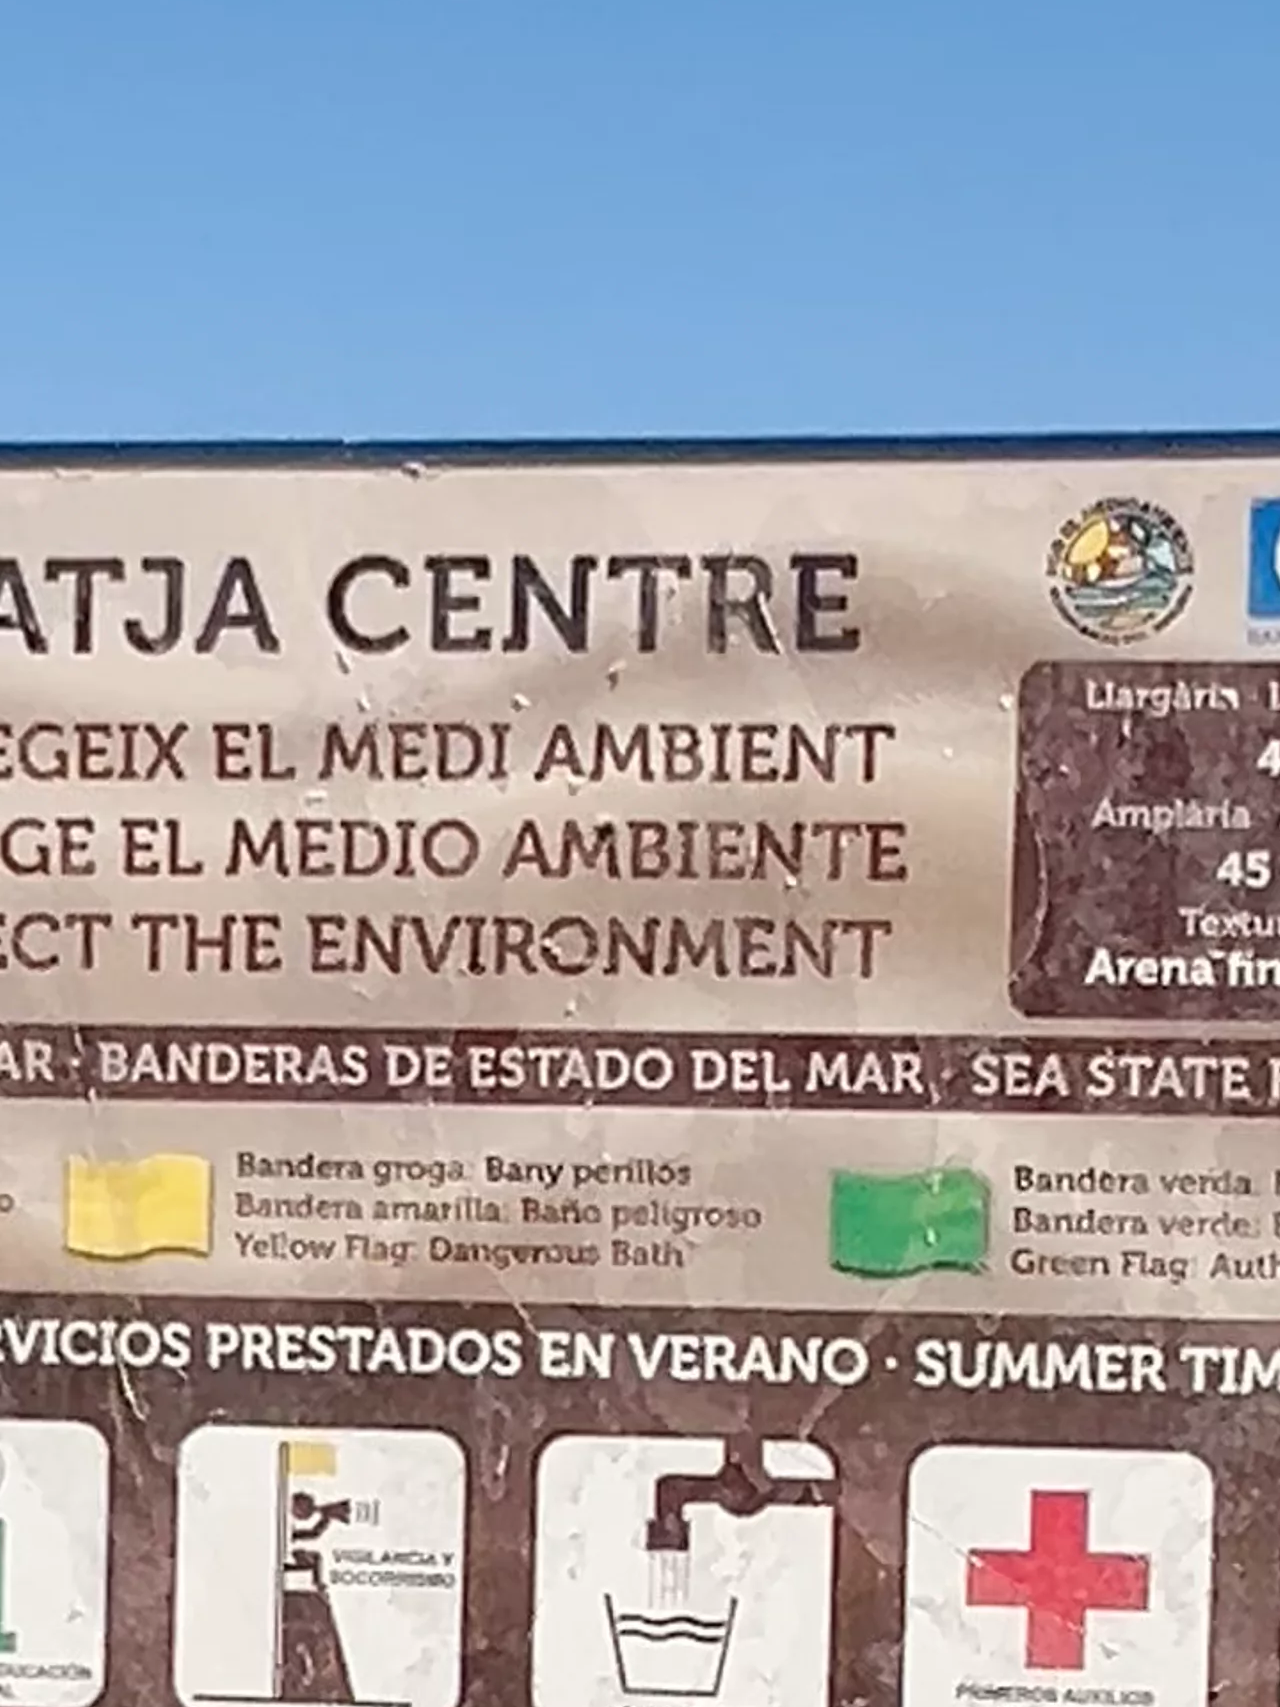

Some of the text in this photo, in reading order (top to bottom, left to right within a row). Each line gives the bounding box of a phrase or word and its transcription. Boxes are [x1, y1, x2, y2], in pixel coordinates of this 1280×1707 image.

[326, 554, 861, 654] CENTRE
[212, 723, 296, 782] EL
[318, 723, 511, 782] MEDI
[534, 723, 896, 783] AMBIENT
[121, 818, 204, 876] EL
[225, 819, 480, 877] MEDIO
[502, 819, 908, 881] AMBIENTE
[1217, 853, 1270, 887] 45
[131, 914, 283, 972] THE
[307, 915, 892, 978] ENVIRONMENT
[1086, 949, 1221, 986] Arena
[99, 1042, 367, 1085] BANDERAS
[385, 1046, 453, 1087] DE
[468, 1047, 673, 1090] ESTADO
[692, 1050, 789, 1092] DEL
[806, 1053, 921, 1093] MAR
[972, 1057, 1069, 1096] SEA
[1088, 1058, 1250, 1099] STATE
[237, 1153, 363, 1179] Bandera
[486, 1157, 563, 1188] Bany
[1014, 1166, 1149, 1194] Bandera
[235, 1193, 362, 1219] Bandera
[522, 1197, 601, 1225] Baño
[611, 1200, 762, 1234] peligroso
[1013, 1207, 1148, 1236] Bandera
[234, 1233, 335, 1261] Yellow
[429, 1237, 597, 1269] Dangerous
[611, 1240, 684, 1268] Bath
[1010, 1249, 1109, 1279] Green
[207, 1329, 521, 1376] PRESTADOS
[538, 1333, 614, 1378] EN
[631, 1336, 869, 1386] VERANO
[915, 1340, 1166, 1395] SUMMER
